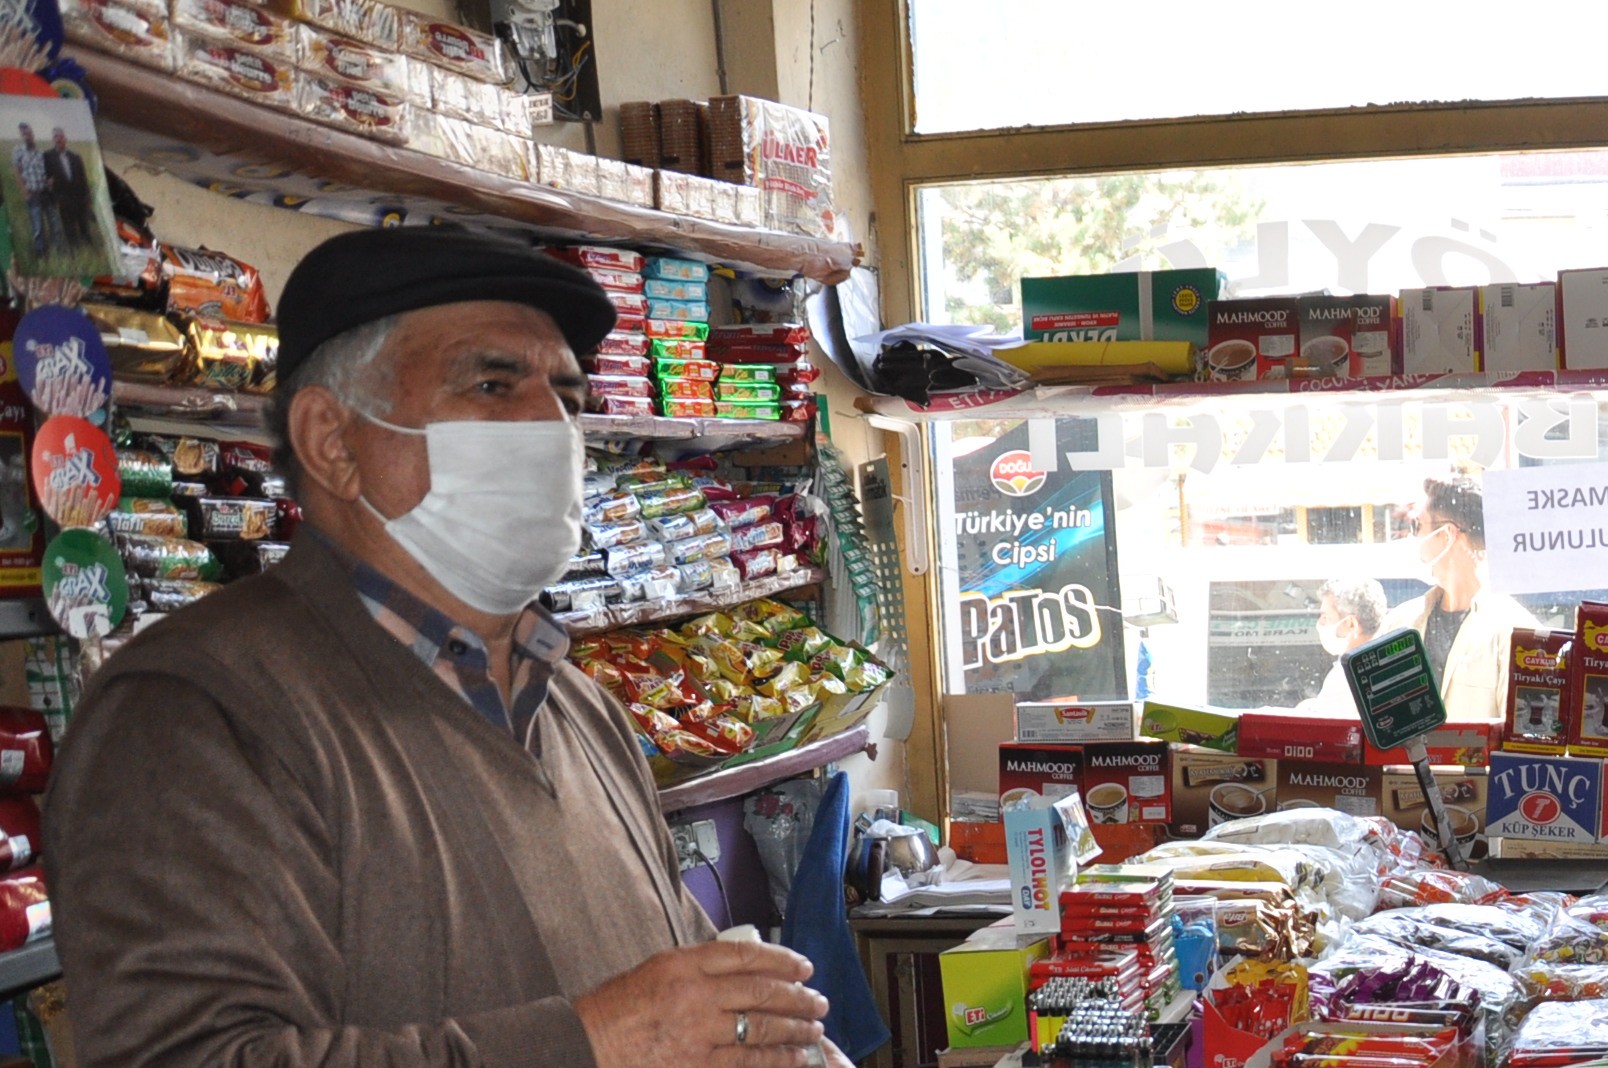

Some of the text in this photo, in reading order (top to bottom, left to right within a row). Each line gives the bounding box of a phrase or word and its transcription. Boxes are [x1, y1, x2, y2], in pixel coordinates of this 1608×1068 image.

[761, 130, 818, 169] ÜLKER
[1216, 310, 1287, 325] MAHMOOD
[1264, 321, 1287, 329] COFFEE
[999, 460, 1032, 475] DOĞU
[954, 505, 1092, 536] Türkiye'nin
[992, 538, 1057, 569] Cipsi
[1513, 672, 1566, 686] Tiryaki Çayı
[1006, 760, 1074, 774] MAHMOOD
[1091, 754, 1160, 768] MAHMOOD
[1137, 764, 1160, 773] COFFEE
[1052, 773, 1074, 781] COFFEE
[1289, 772, 1366, 789] MAHMOOD
[1341, 787, 1367, 796] COFFEE
[1494, 763, 1591, 810] TUNÇ
[1532, 798, 1552, 819] T
[1501, 820, 1576, 839] KÜP ŞEKER
[1026, 827, 1051, 913] TYLOLHOT
[966, 1006, 985, 1026] ETi
